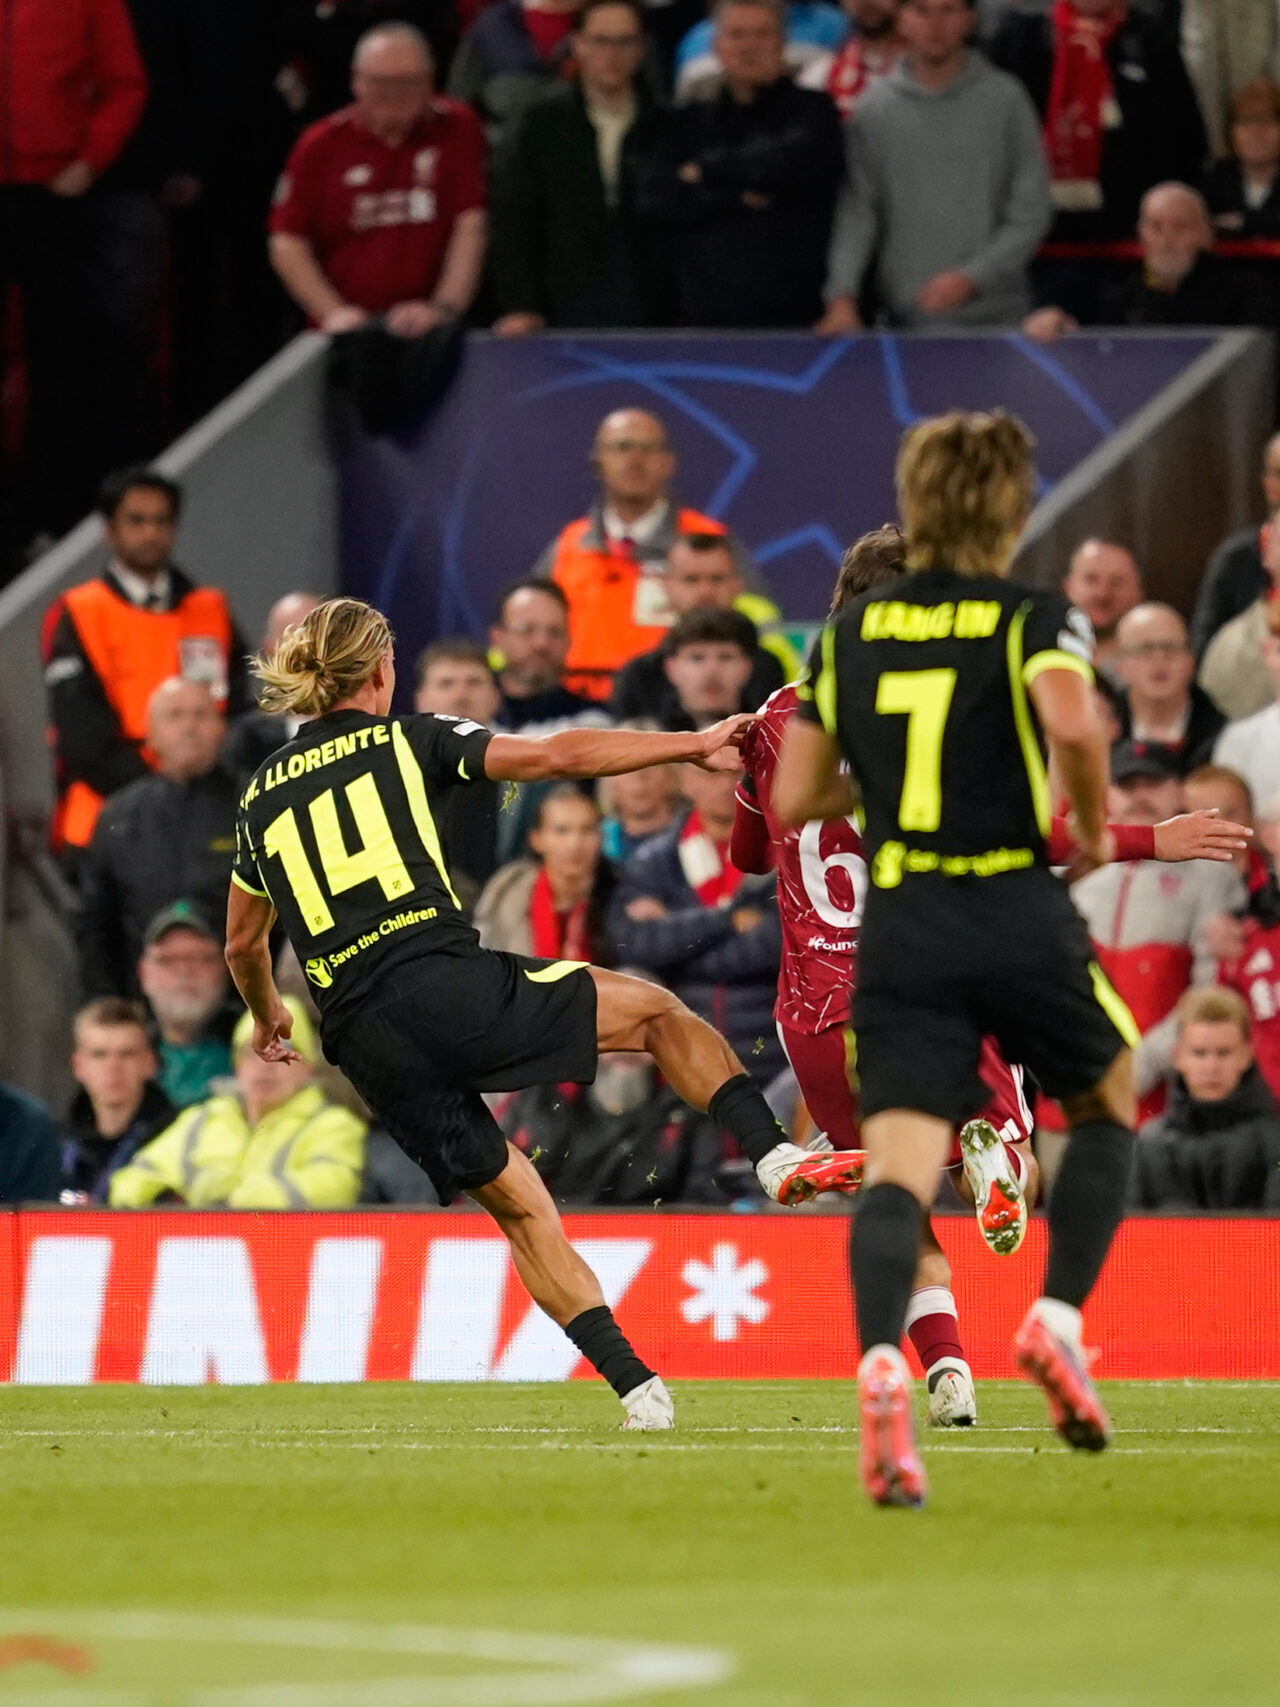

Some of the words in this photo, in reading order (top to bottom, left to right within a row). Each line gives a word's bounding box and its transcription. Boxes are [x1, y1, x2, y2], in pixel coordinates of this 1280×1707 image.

[265, 724, 390, 791] LLORENTE
[876, 667, 957, 833] 7
[264, 771, 415, 937] 14
[798, 814, 869, 929] 6
[328, 944, 359, 968] Save
[357, 931, 380, 950] the
[379, 906, 438, 936] Children
